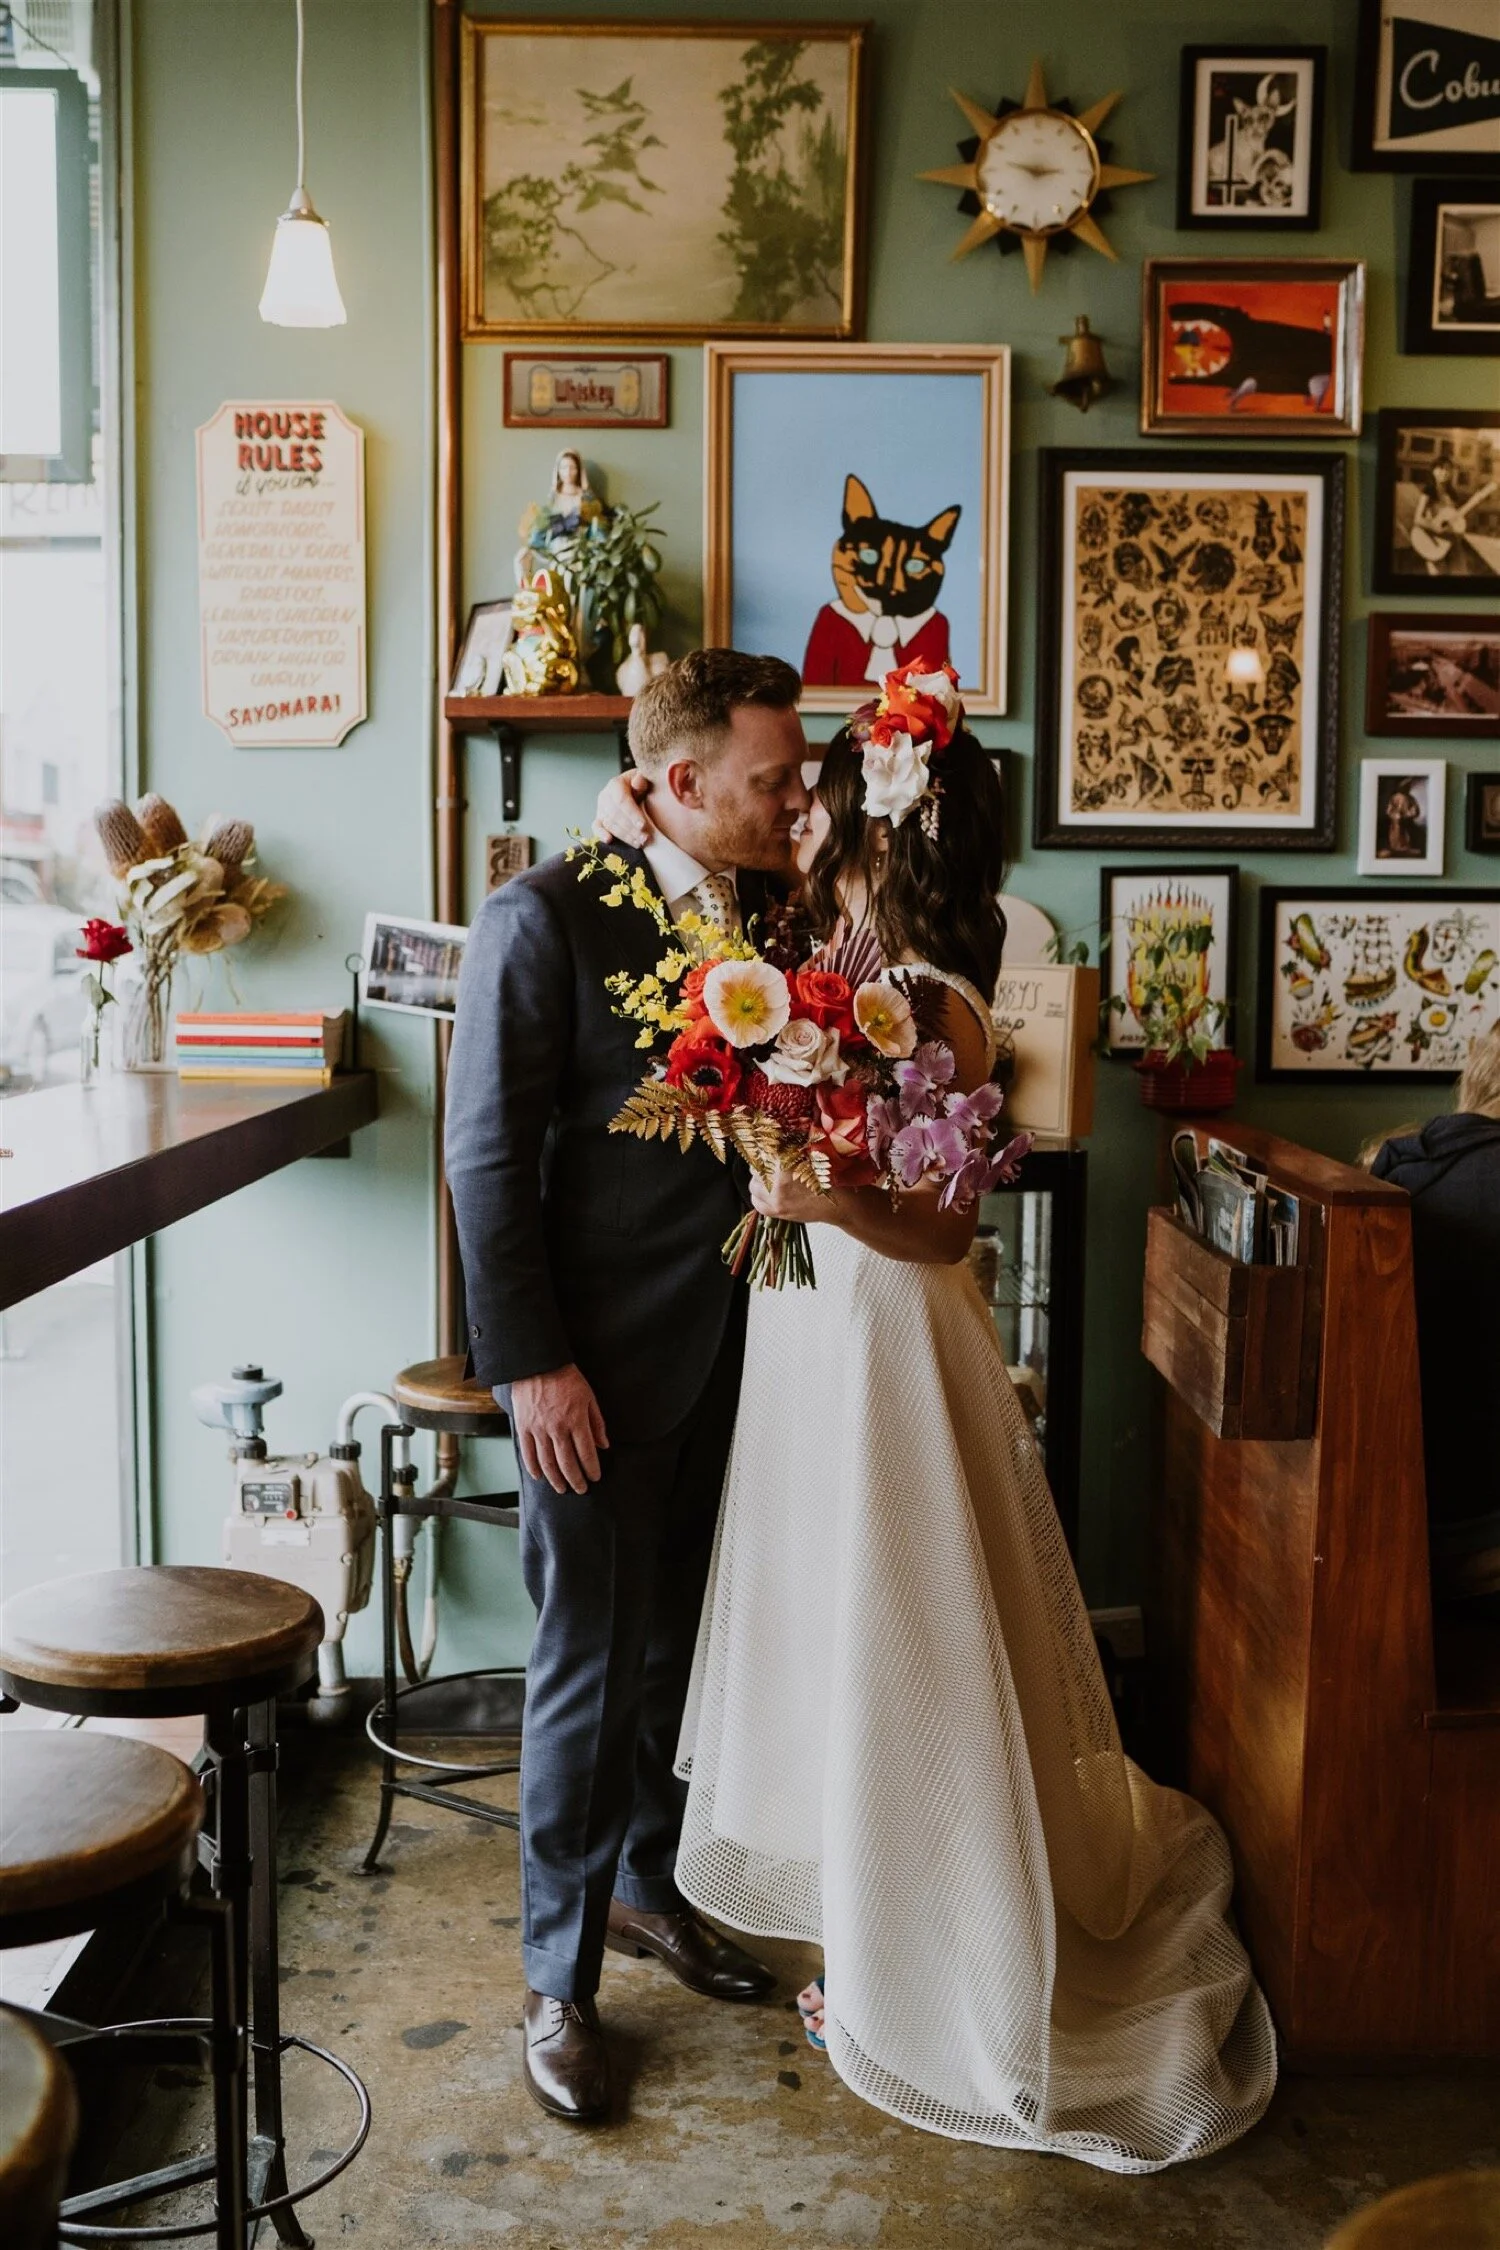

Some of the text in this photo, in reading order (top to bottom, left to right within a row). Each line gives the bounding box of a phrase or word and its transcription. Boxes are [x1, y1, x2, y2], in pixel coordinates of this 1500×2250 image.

[1400, 50, 1500, 109] Cobu
[235, 412, 326, 440] HOUSE
[239, 444, 323, 472] RULES
[228, 694, 342, 728] SAYONARA!
